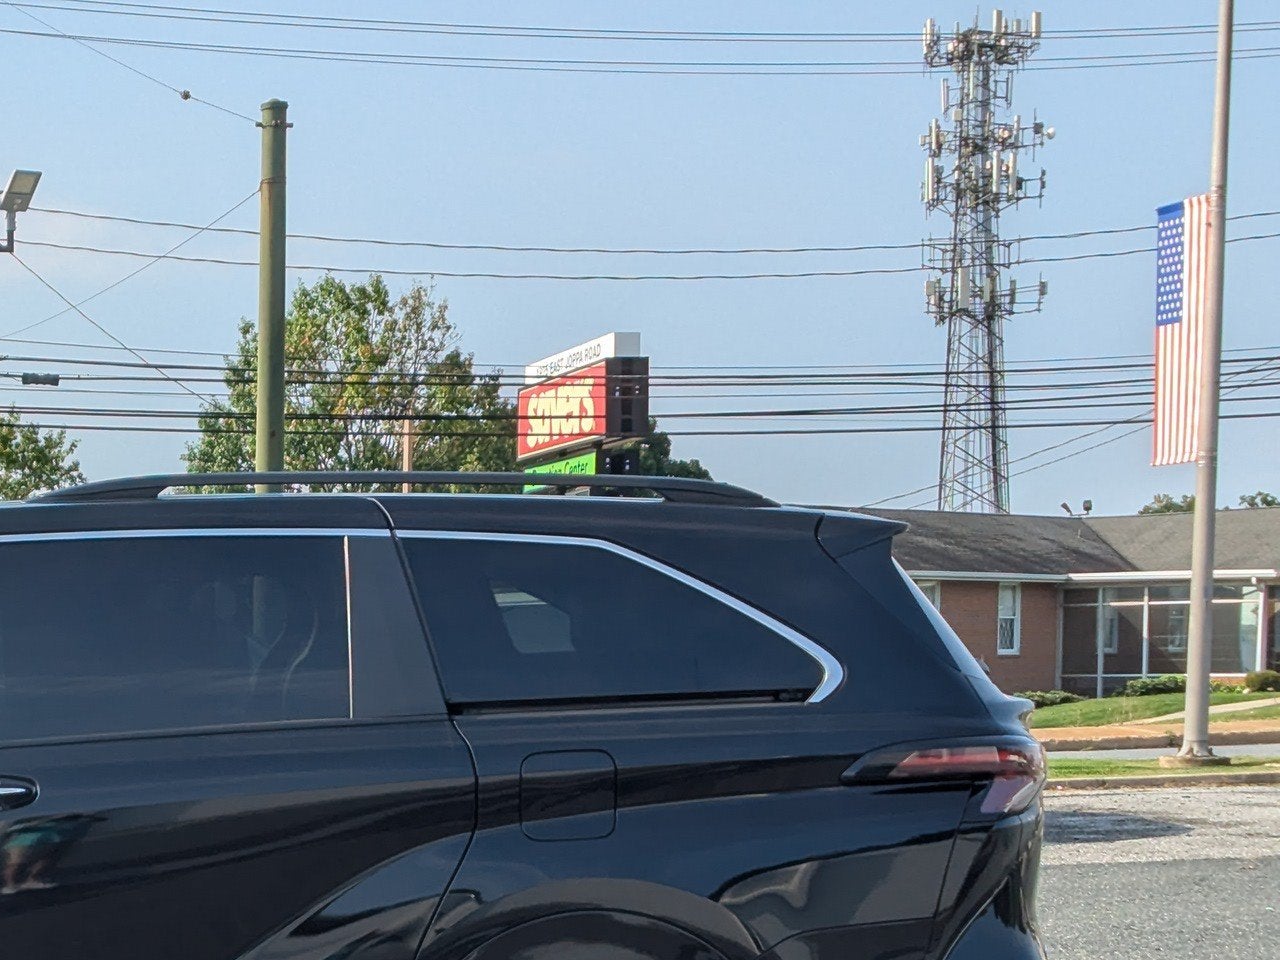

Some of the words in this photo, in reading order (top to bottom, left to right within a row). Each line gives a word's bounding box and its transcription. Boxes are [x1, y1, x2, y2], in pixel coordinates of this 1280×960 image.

[549, 357, 564, 374] EAST
[565, 351, 583, 369] JOPPA
[584, 343, 602, 362] ROAD
